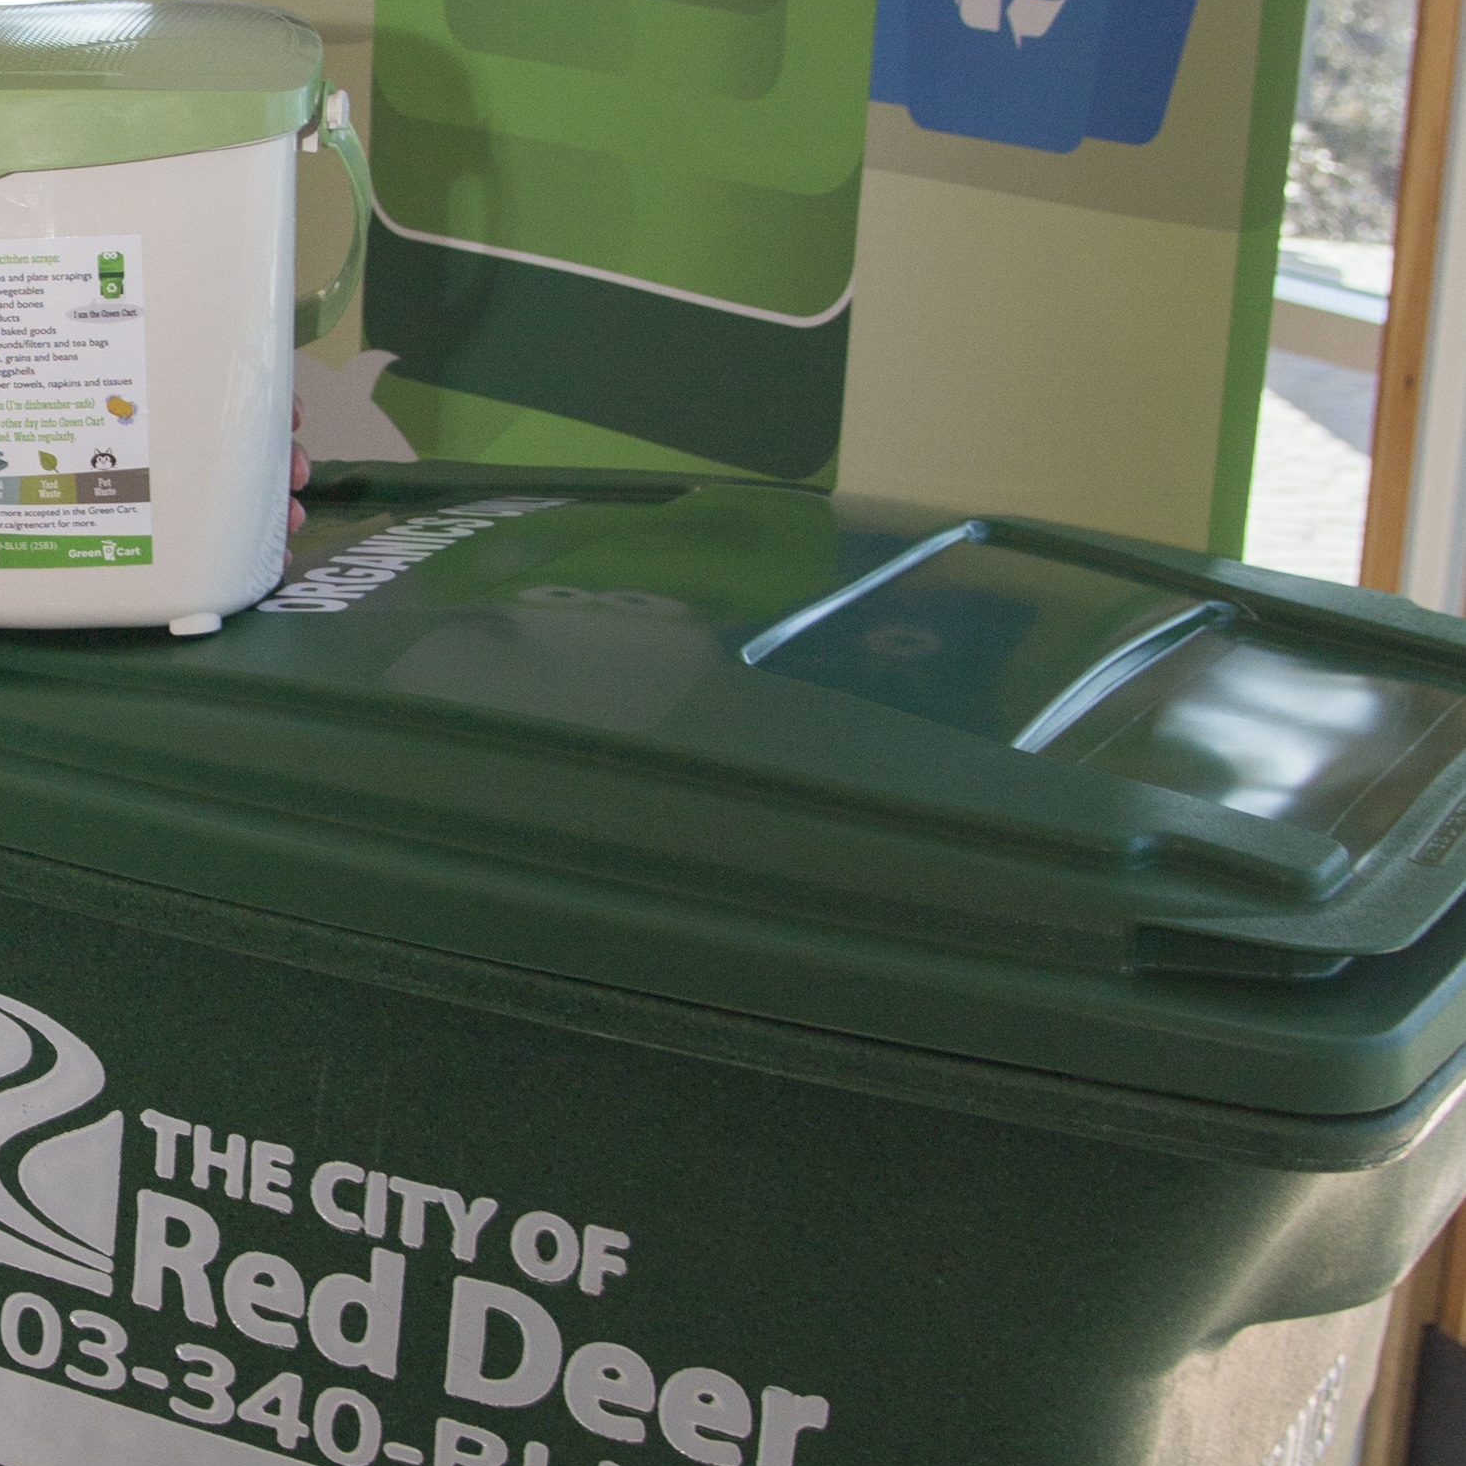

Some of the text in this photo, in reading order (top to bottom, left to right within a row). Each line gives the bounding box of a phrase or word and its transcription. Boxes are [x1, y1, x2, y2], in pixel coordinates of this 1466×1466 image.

[8, 274, 24, 282] and
[27, 274, 49, 283] plate
[51, 273, 92, 282] scrapings
[0, 287, 44, 297] vegetables
[0, 300, 14, 308] and
[17, 300, 43, 308] bones
[30, 328, 56, 337] goods
[89, 339, 108, 348] bags
[5, 354, 31, 364] grains
[53, 353, 78, 361] beans
[13, 380, 44, 389] towels,
[48, 380, 80, 389] napkins
[84, 379, 100, 387] and
[103, 378, 132, 386] tissues
[0, 418, 20, 428] other
[23, 417, 38, 429] day
[41, 417, 56, 427] into
[59, 417, 83, 427] Green
[86, 417, 104, 426] Cart
[24, 508, 60, 517] accepted
[73, 507, 85, 515] the
[88, 506, 114, 515] Green
[117, 506, 138, 514] Cart.
[31, 542, 57, 550] (2583)
[69, 547, 140, 558] Green Cart
[256, 517, 494, 612] ORGANICS
[140, 1108, 630, 1295] THE CITY OF
[132, 1187, 404, 1380] Red
